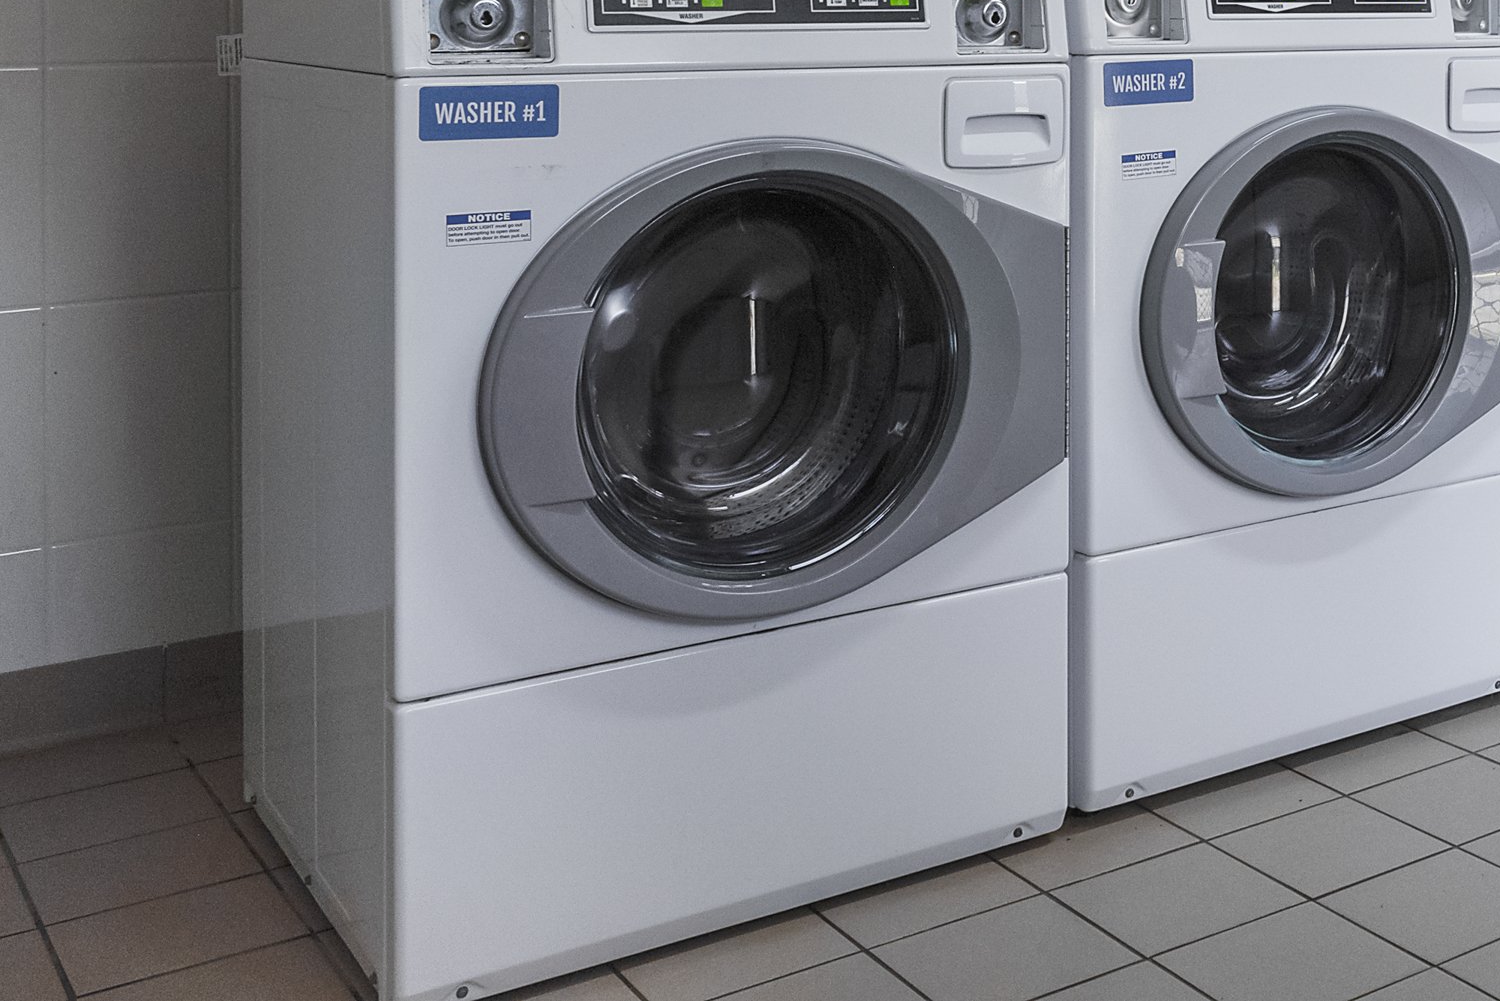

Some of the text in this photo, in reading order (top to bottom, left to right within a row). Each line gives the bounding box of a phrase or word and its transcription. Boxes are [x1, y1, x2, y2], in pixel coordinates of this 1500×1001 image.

[1112, 72, 1186, 93] WASHER #2
[435, 100, 546, 124] WASHER #1
[1135, 153, 1163, 161] NOTICE
[468, 212, 511, 222] NOTICE
